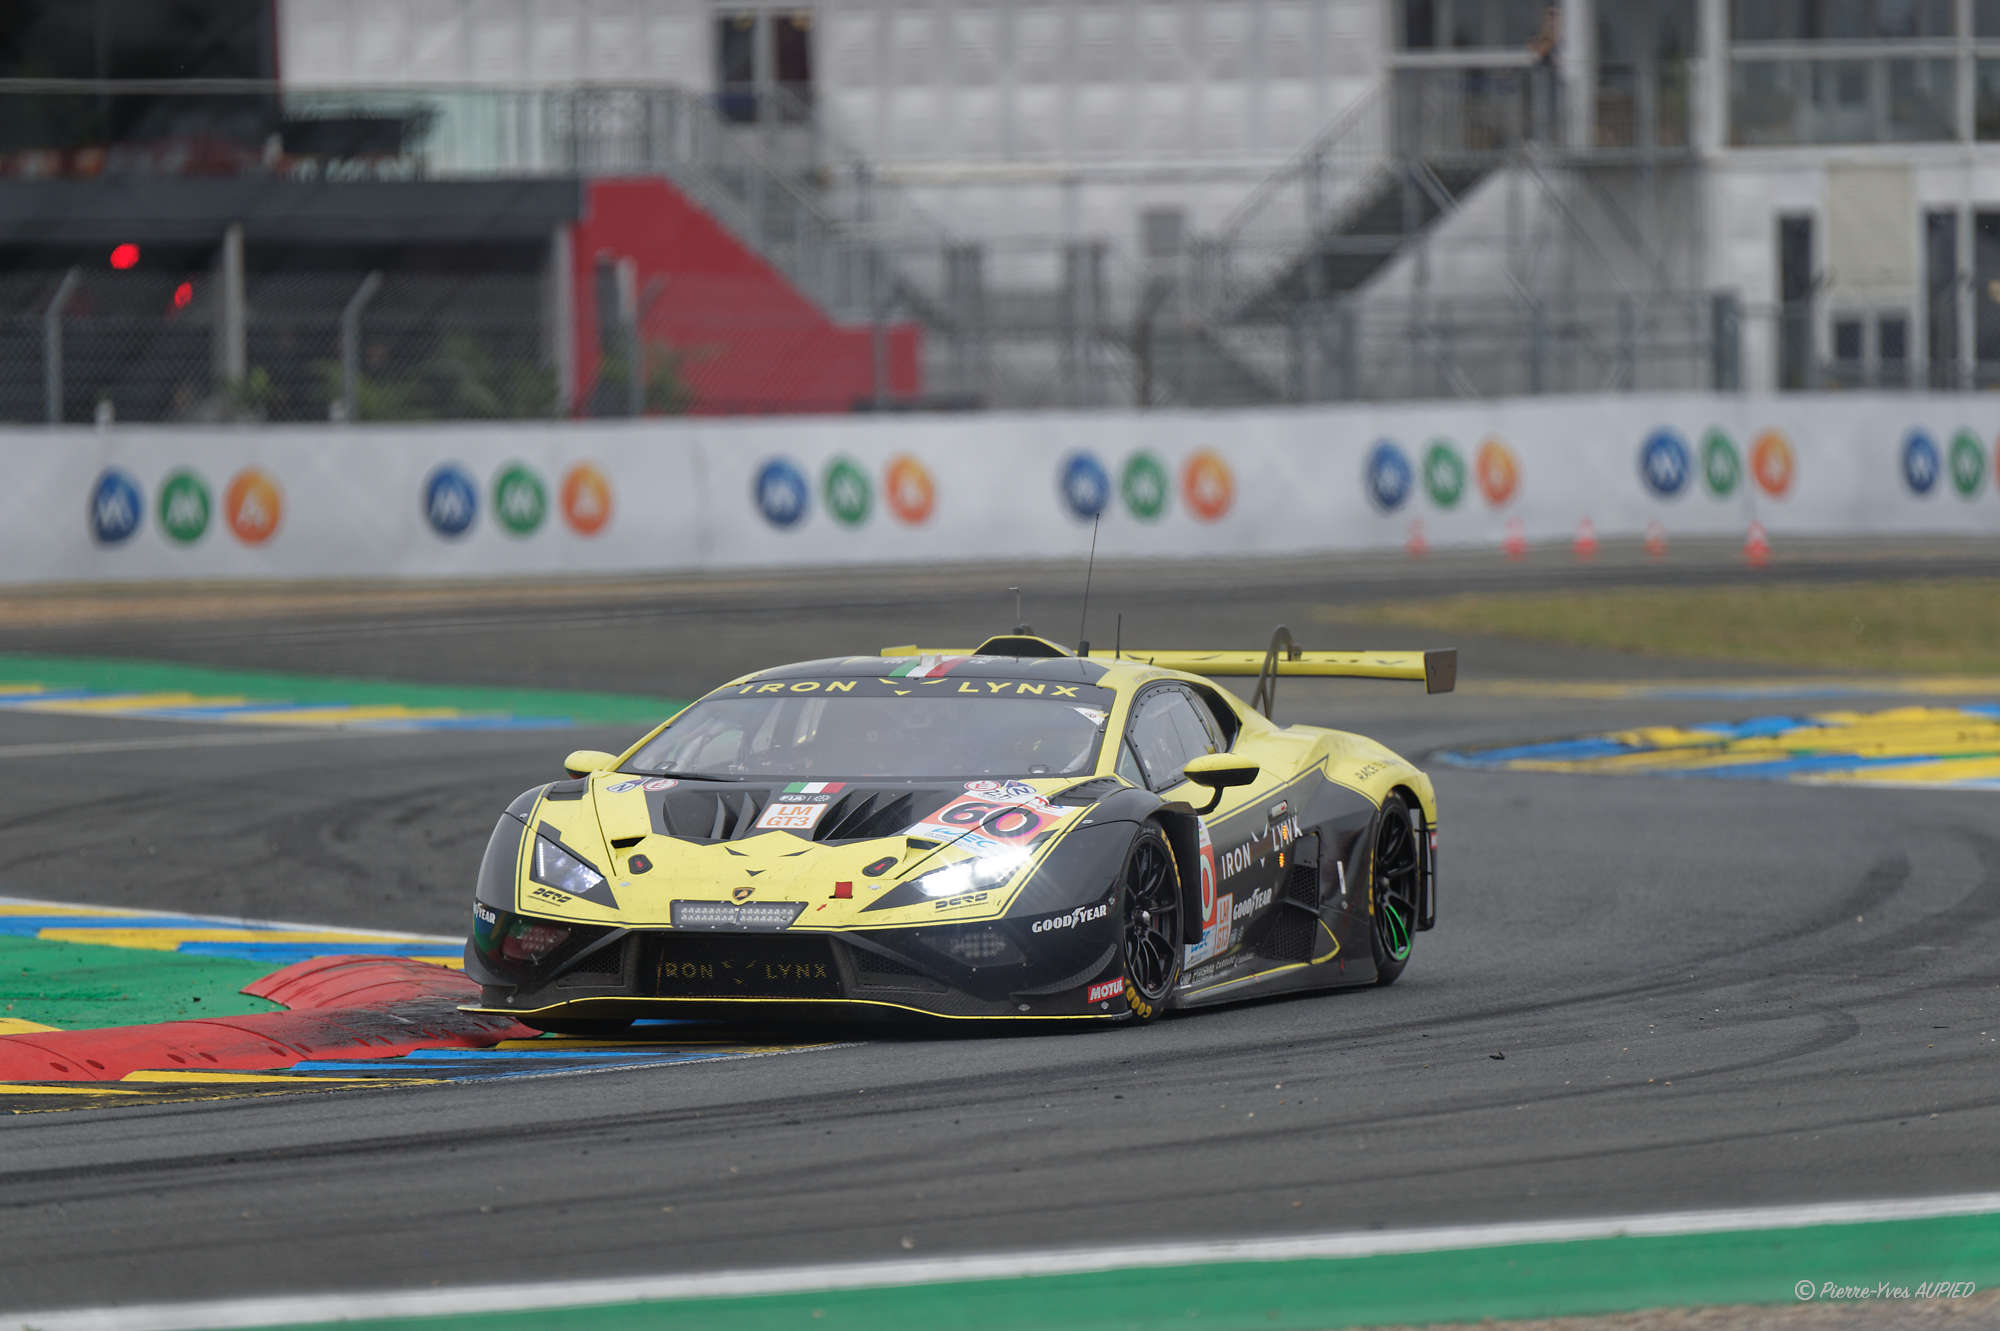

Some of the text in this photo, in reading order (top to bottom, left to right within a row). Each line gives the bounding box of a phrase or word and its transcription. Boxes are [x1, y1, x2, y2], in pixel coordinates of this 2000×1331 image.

[738, 680, 1081, 698] IRON LYNX
[766, 816, 809, 826] GT3
[777, 806, 814, 816] LM
[938, 801, 1042, 838] 60
[1221, 811, 1303, 880] IRON LYNX
[1232, 887, 1273, 920] GOODYEAR
[1032, 904, 1107, 933] GOODYEAR
[657, 961, 827, 979] IRON LYNX
[1089, 979, 1123, 1001] MOTUL
